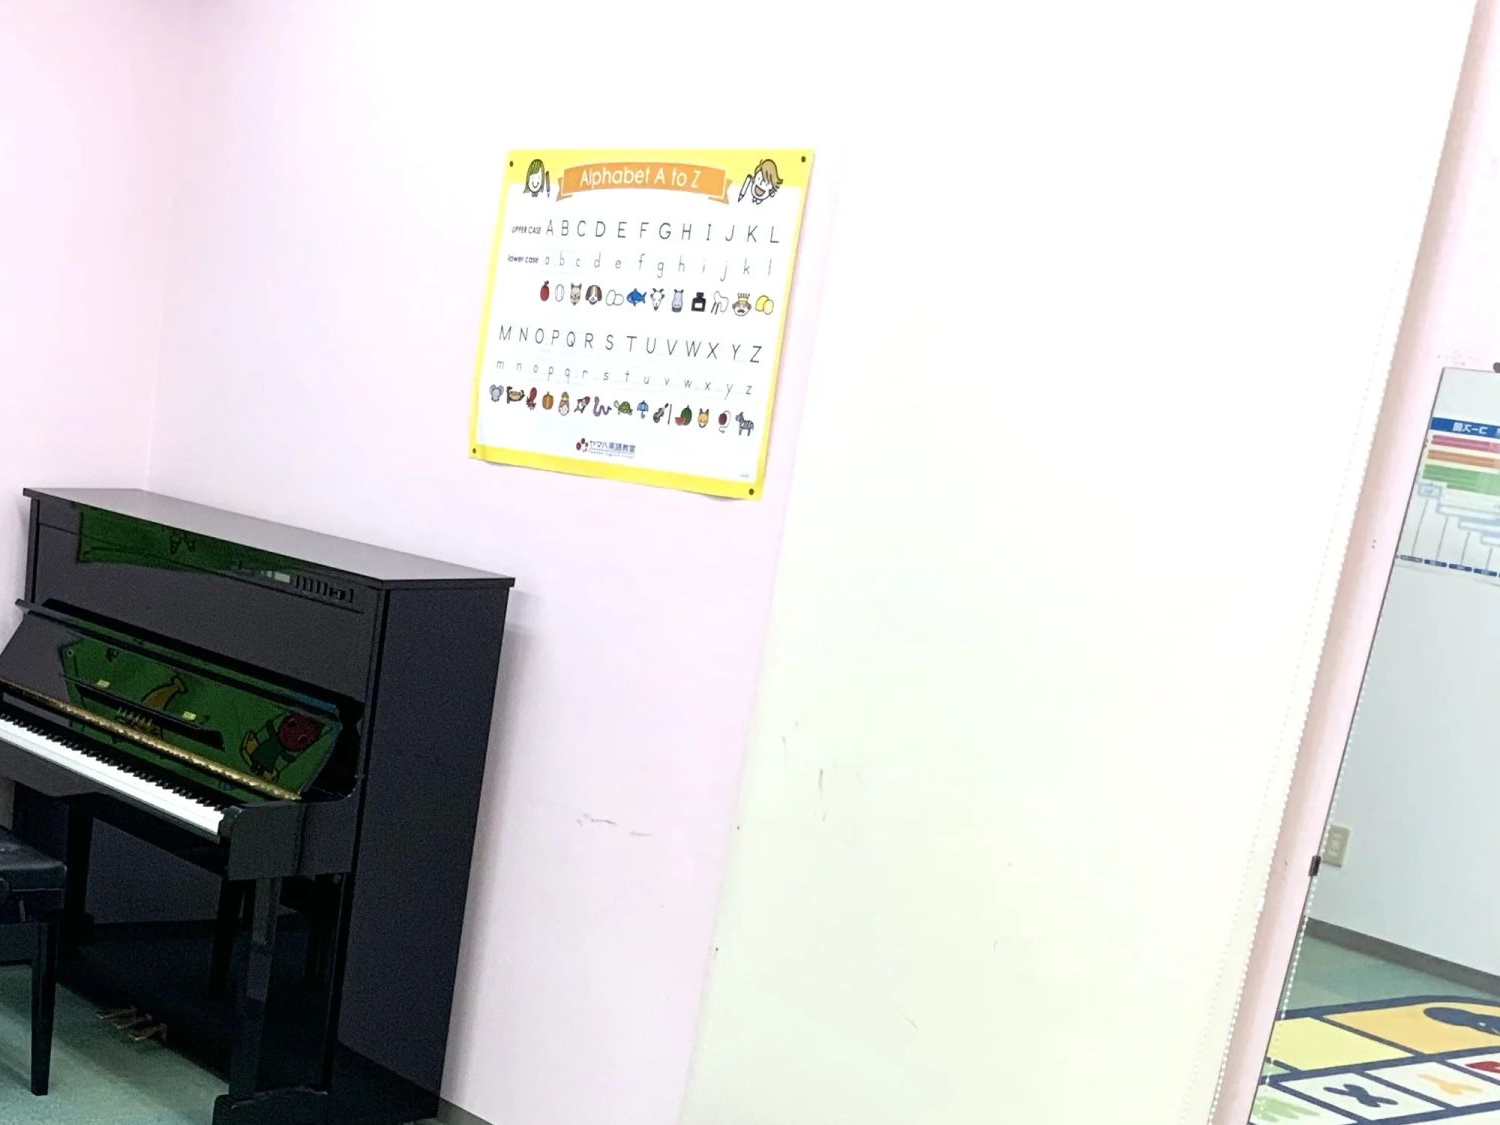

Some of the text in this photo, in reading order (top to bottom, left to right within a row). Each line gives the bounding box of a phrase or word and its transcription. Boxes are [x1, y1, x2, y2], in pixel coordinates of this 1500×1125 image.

[580, 166, 702, 189] Alphabet A to Z
[546, 219, 554, 236] A
[561, 220, 569, 236] B
[577, 220, 587, 237] C
[595, 221, 606, 237] D
[617, 221, 627, 238] E
[639, 222, 649, 239] F
[658, 222, 671, 240] G
[681, 223, 692, 240] H
[706, 224, 712, 241] I
[725, 225, 735, 242] J
[746, 225, 758, 243] K
[769, 226, 779, 244] L
[499, 325, 762, 363] M N O P Q R S T U V W X Y Z
